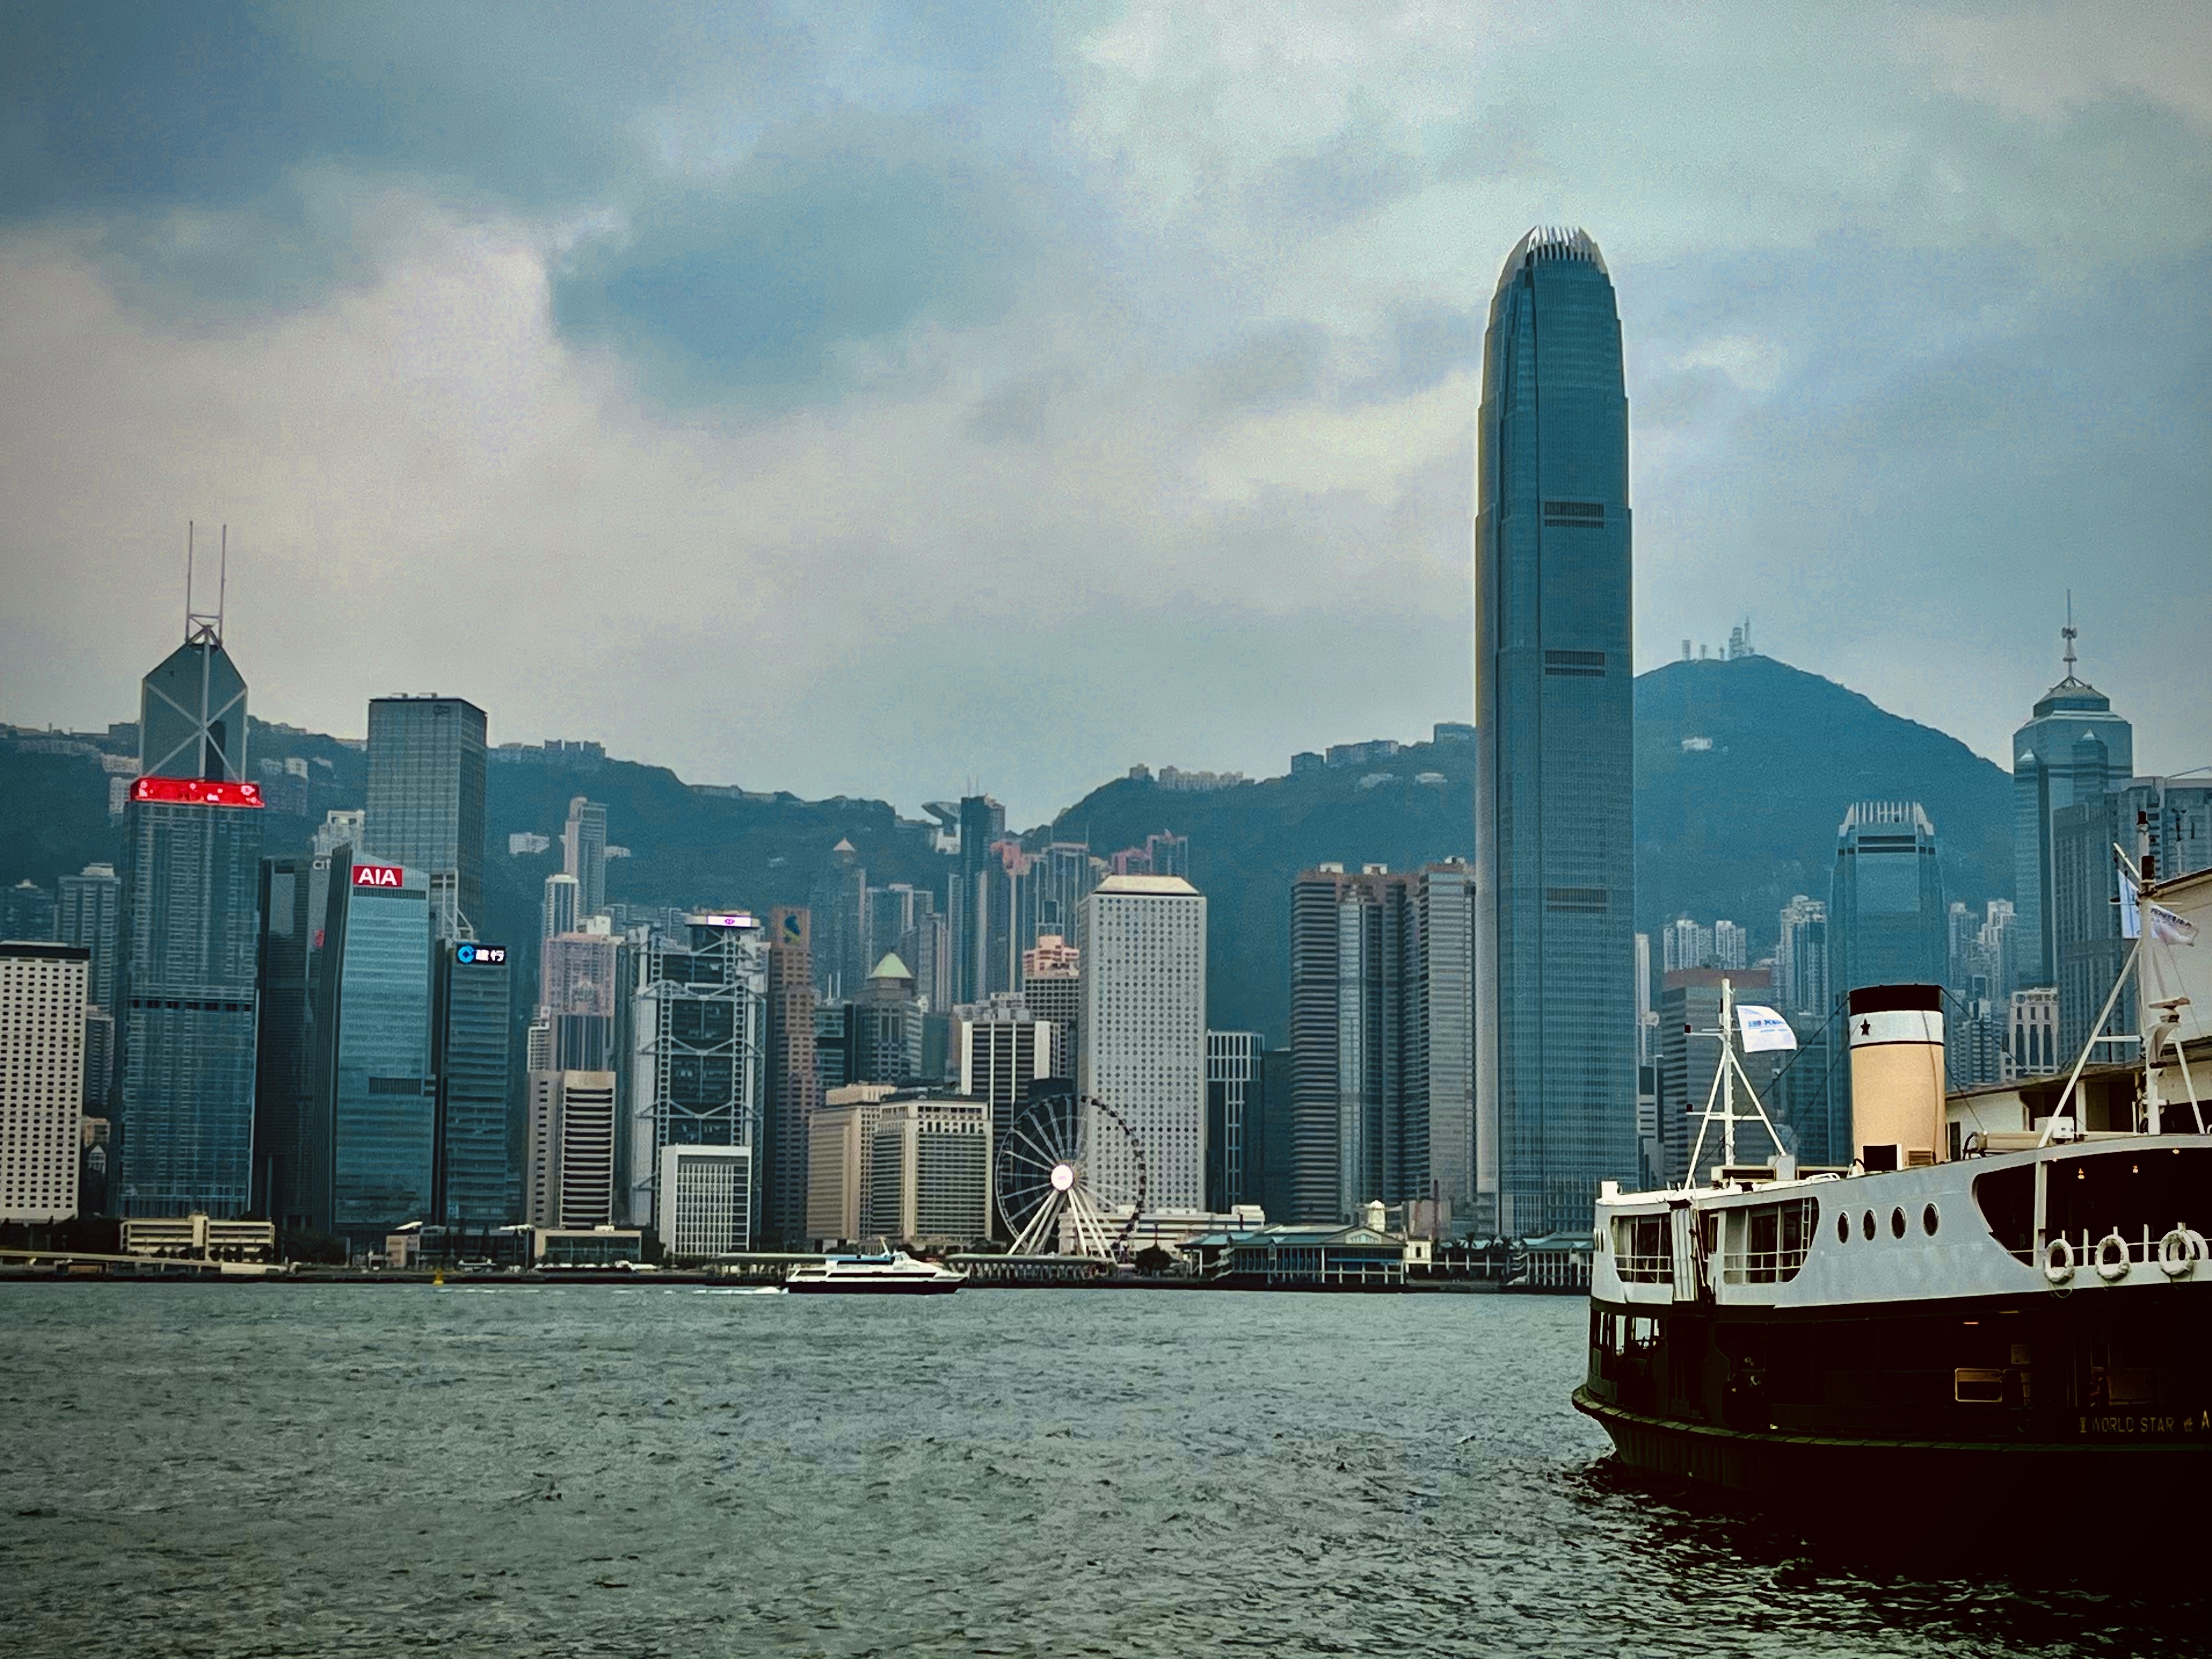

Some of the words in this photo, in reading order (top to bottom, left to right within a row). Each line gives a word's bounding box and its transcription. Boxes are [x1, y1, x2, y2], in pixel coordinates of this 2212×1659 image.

[358, 868, 397, 885] AIA
[2091, 1417, 2134, 1432] WORLD
[2141, 1417, 2174, 1432] STAR
